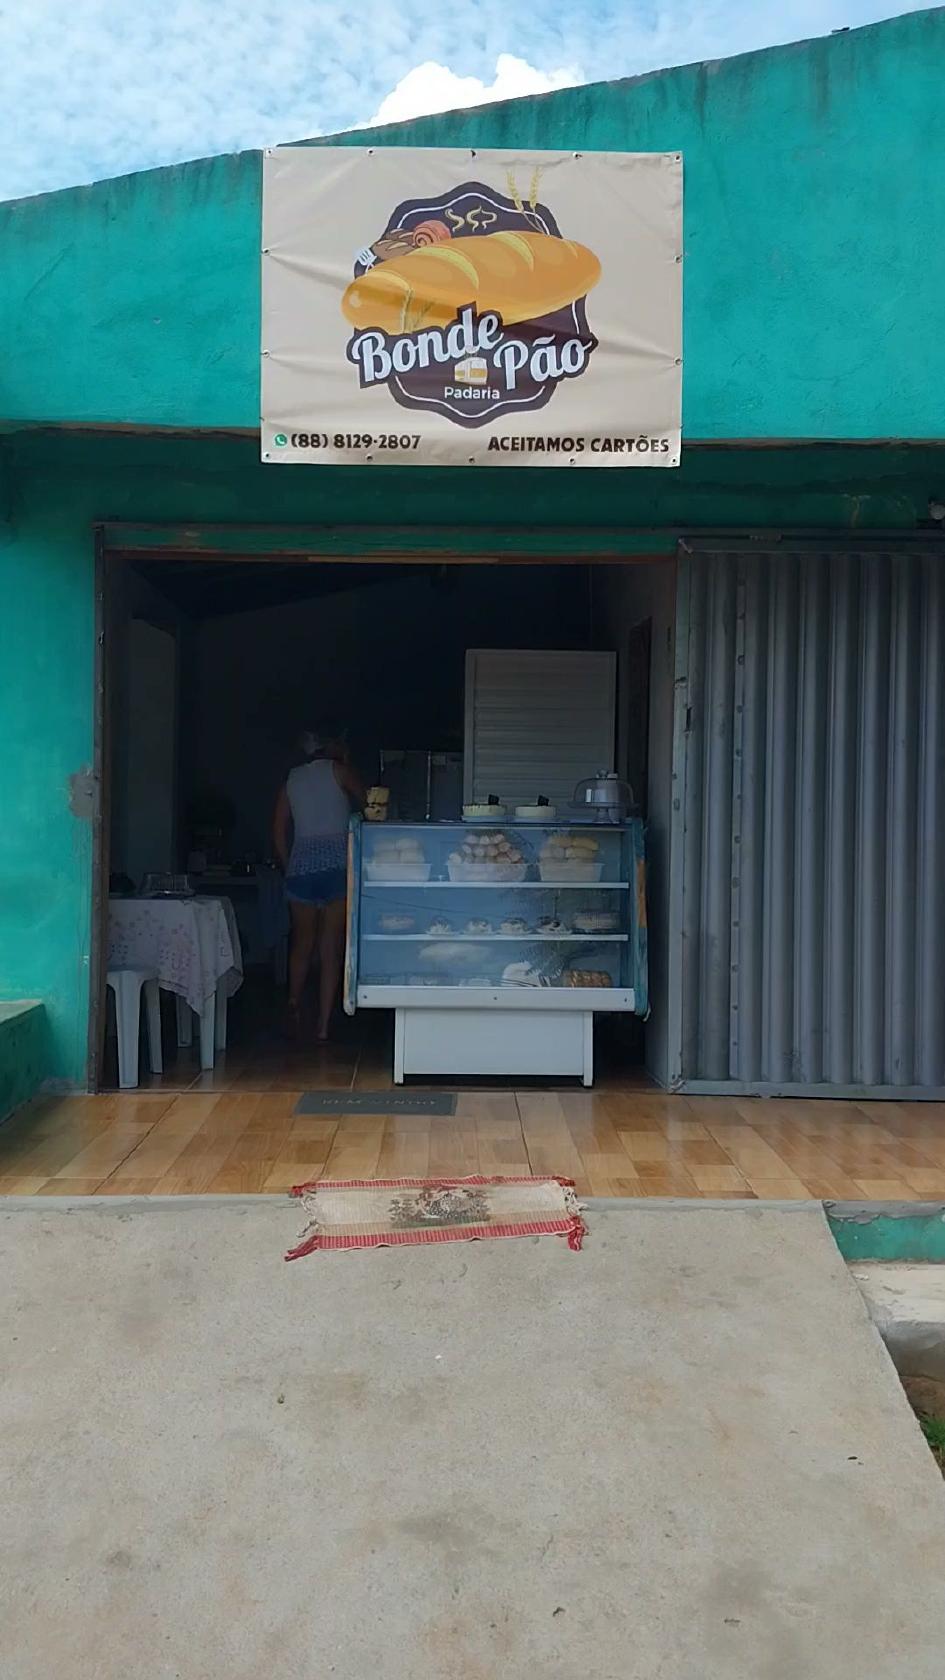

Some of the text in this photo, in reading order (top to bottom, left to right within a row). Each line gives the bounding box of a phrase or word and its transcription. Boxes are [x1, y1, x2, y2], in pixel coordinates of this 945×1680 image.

[352, 306, 593, 390] Bonde Pão
[444, 386, 500, 400] Padaria
[291, 433, 421, 450] (88) 8129-2807
[488, 434, 670, 454] ACEITAMOS CARTÕES
